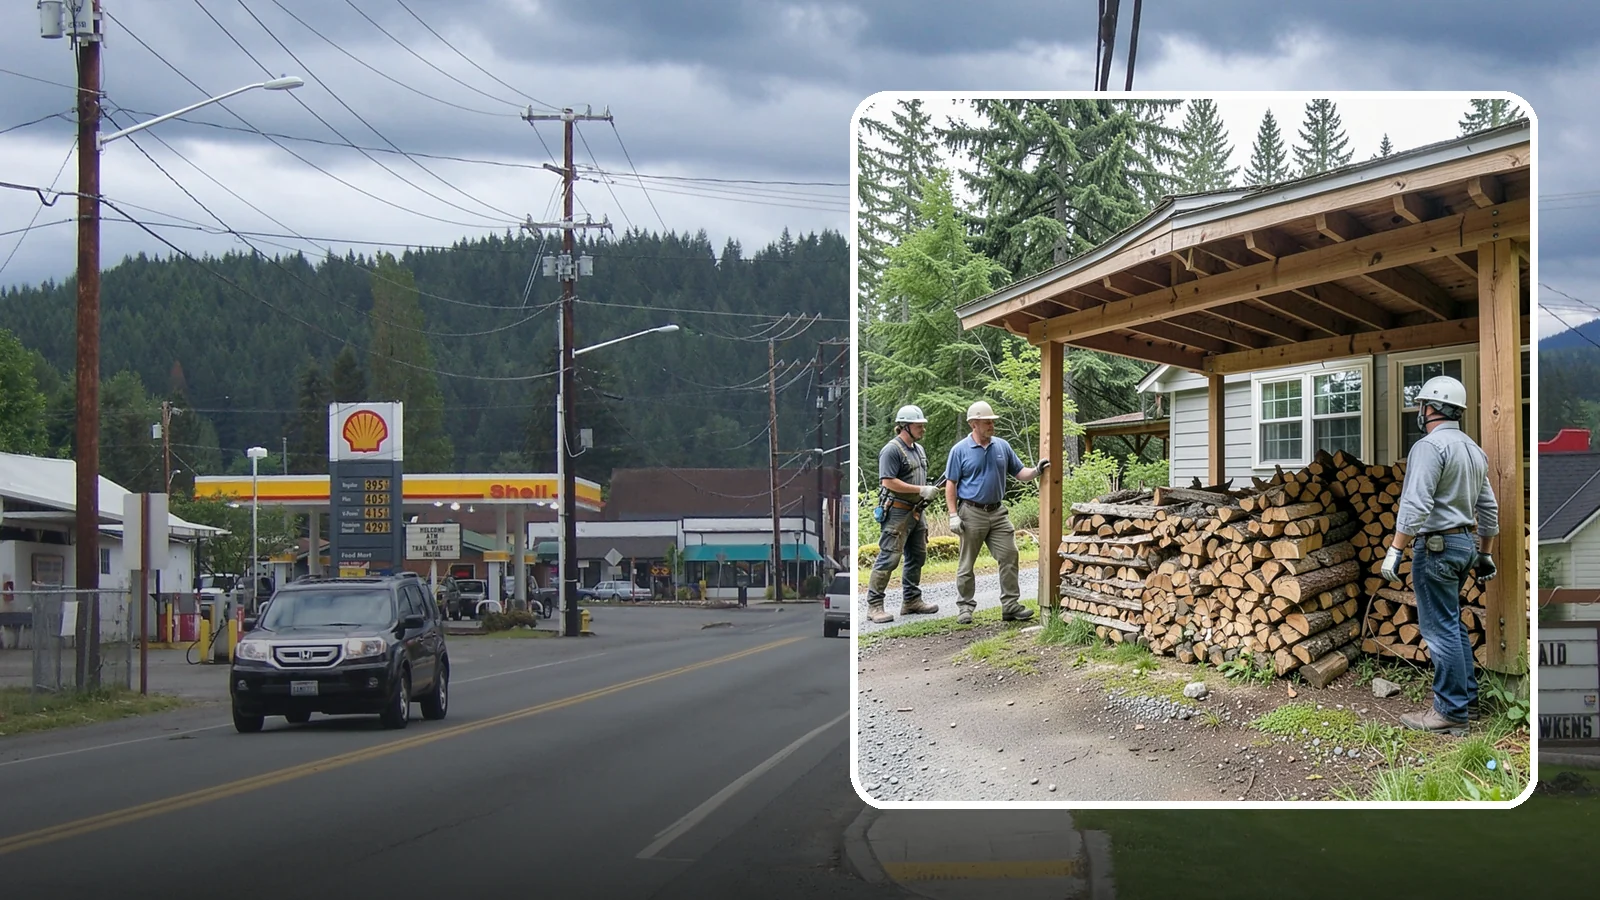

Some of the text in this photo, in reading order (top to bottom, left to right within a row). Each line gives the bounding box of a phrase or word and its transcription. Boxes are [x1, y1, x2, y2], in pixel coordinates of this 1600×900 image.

[366, 480, 384, 490] 395
[490, 484, 547, 499] Shell
[366, 494, 384, 504] 405
[366, 508, 384, 518] 415
[366, 522, 384, 532] 429
[1539, 643, 1567, 665] AID
